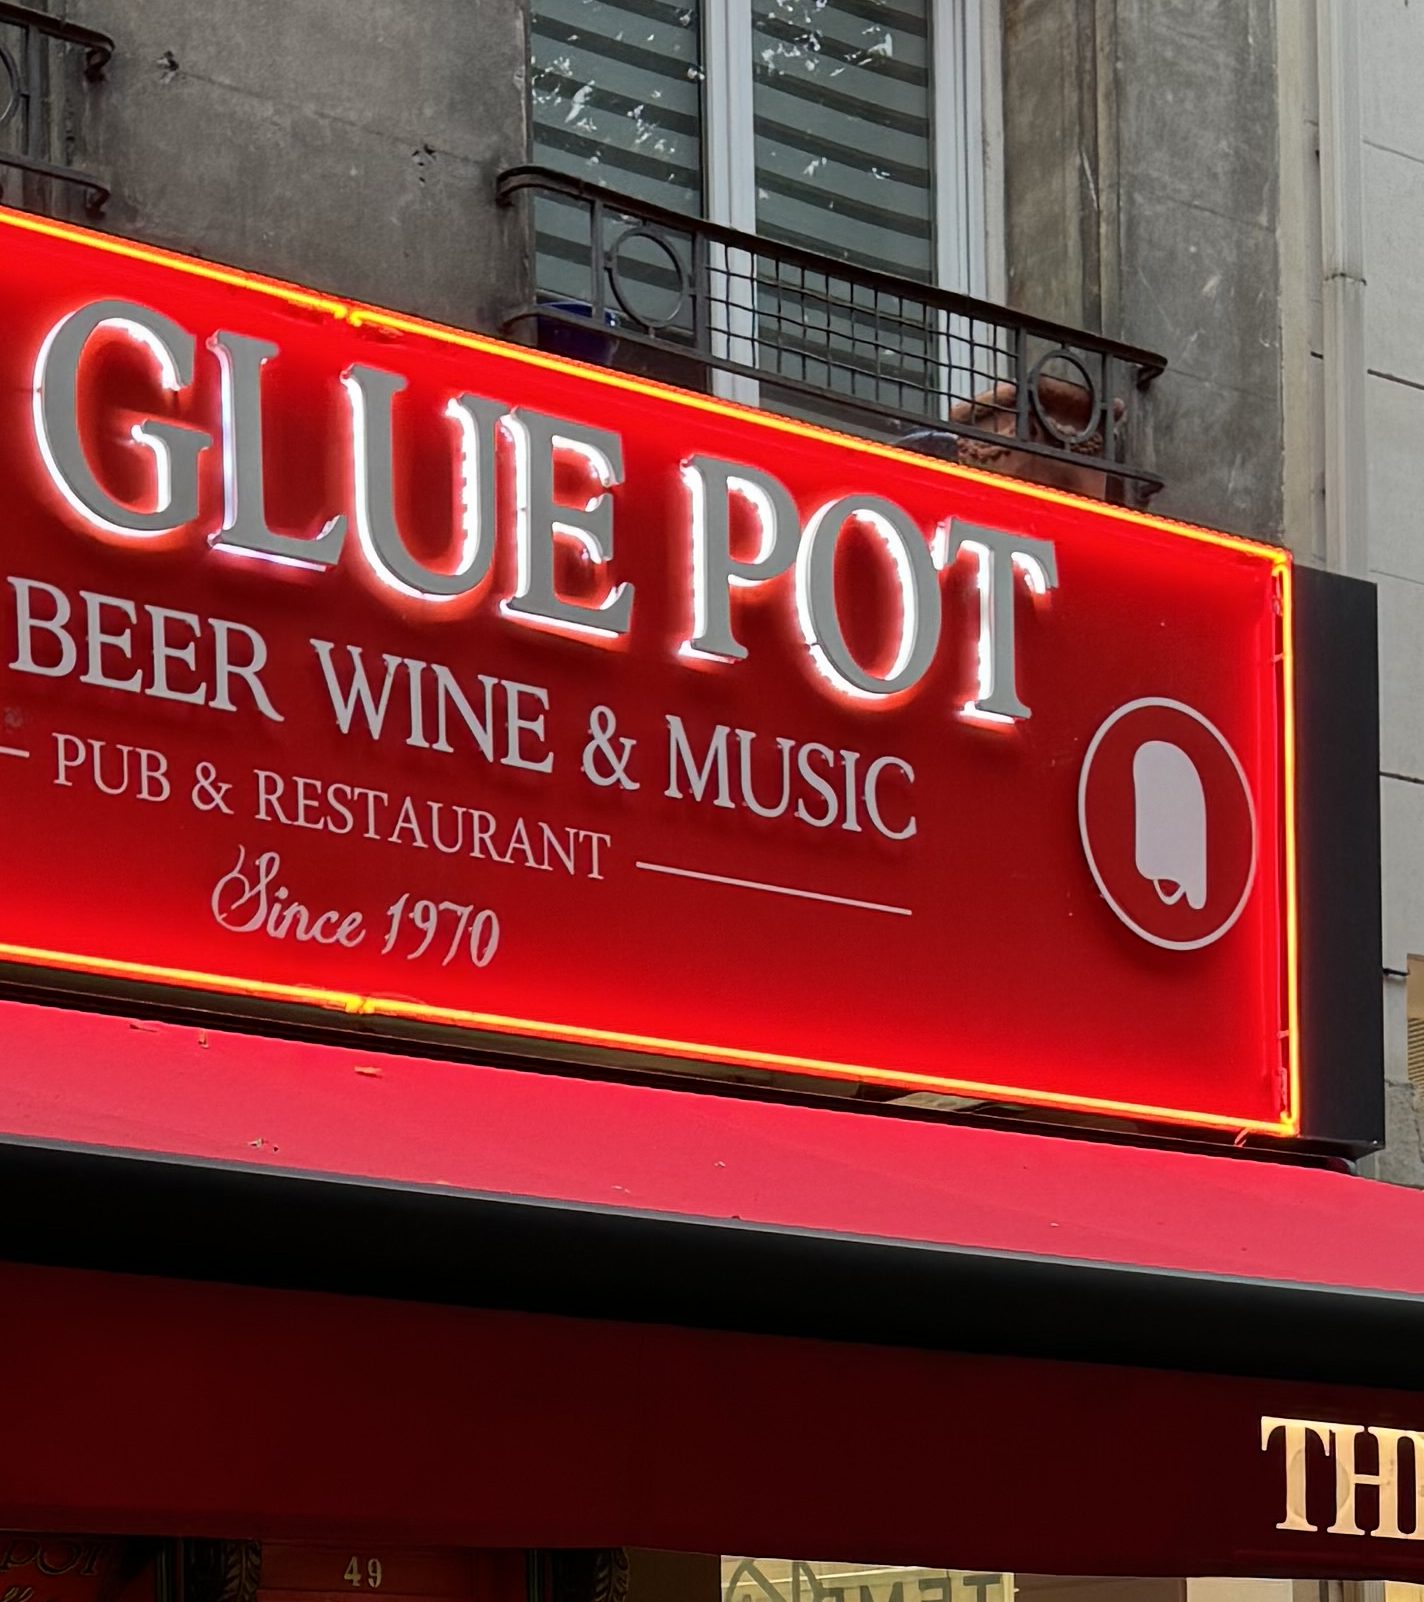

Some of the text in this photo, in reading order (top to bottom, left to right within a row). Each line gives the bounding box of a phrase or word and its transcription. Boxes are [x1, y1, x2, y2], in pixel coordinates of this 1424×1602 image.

[32, 298, 635, 638] GLUE
[677, 455, 1060, 724] POT
[7, 576, 285, 722] BEER
[310, 638, 555, 774] WINE
[582, 705, 641, 792] &
[665, 714, 919, 841] MUSIC
[53, 733, 612, 879] PUB & RESTAURANT
[212, 844, 501, 968] Since 1970
[344, 1556, 382, 1588] 49
